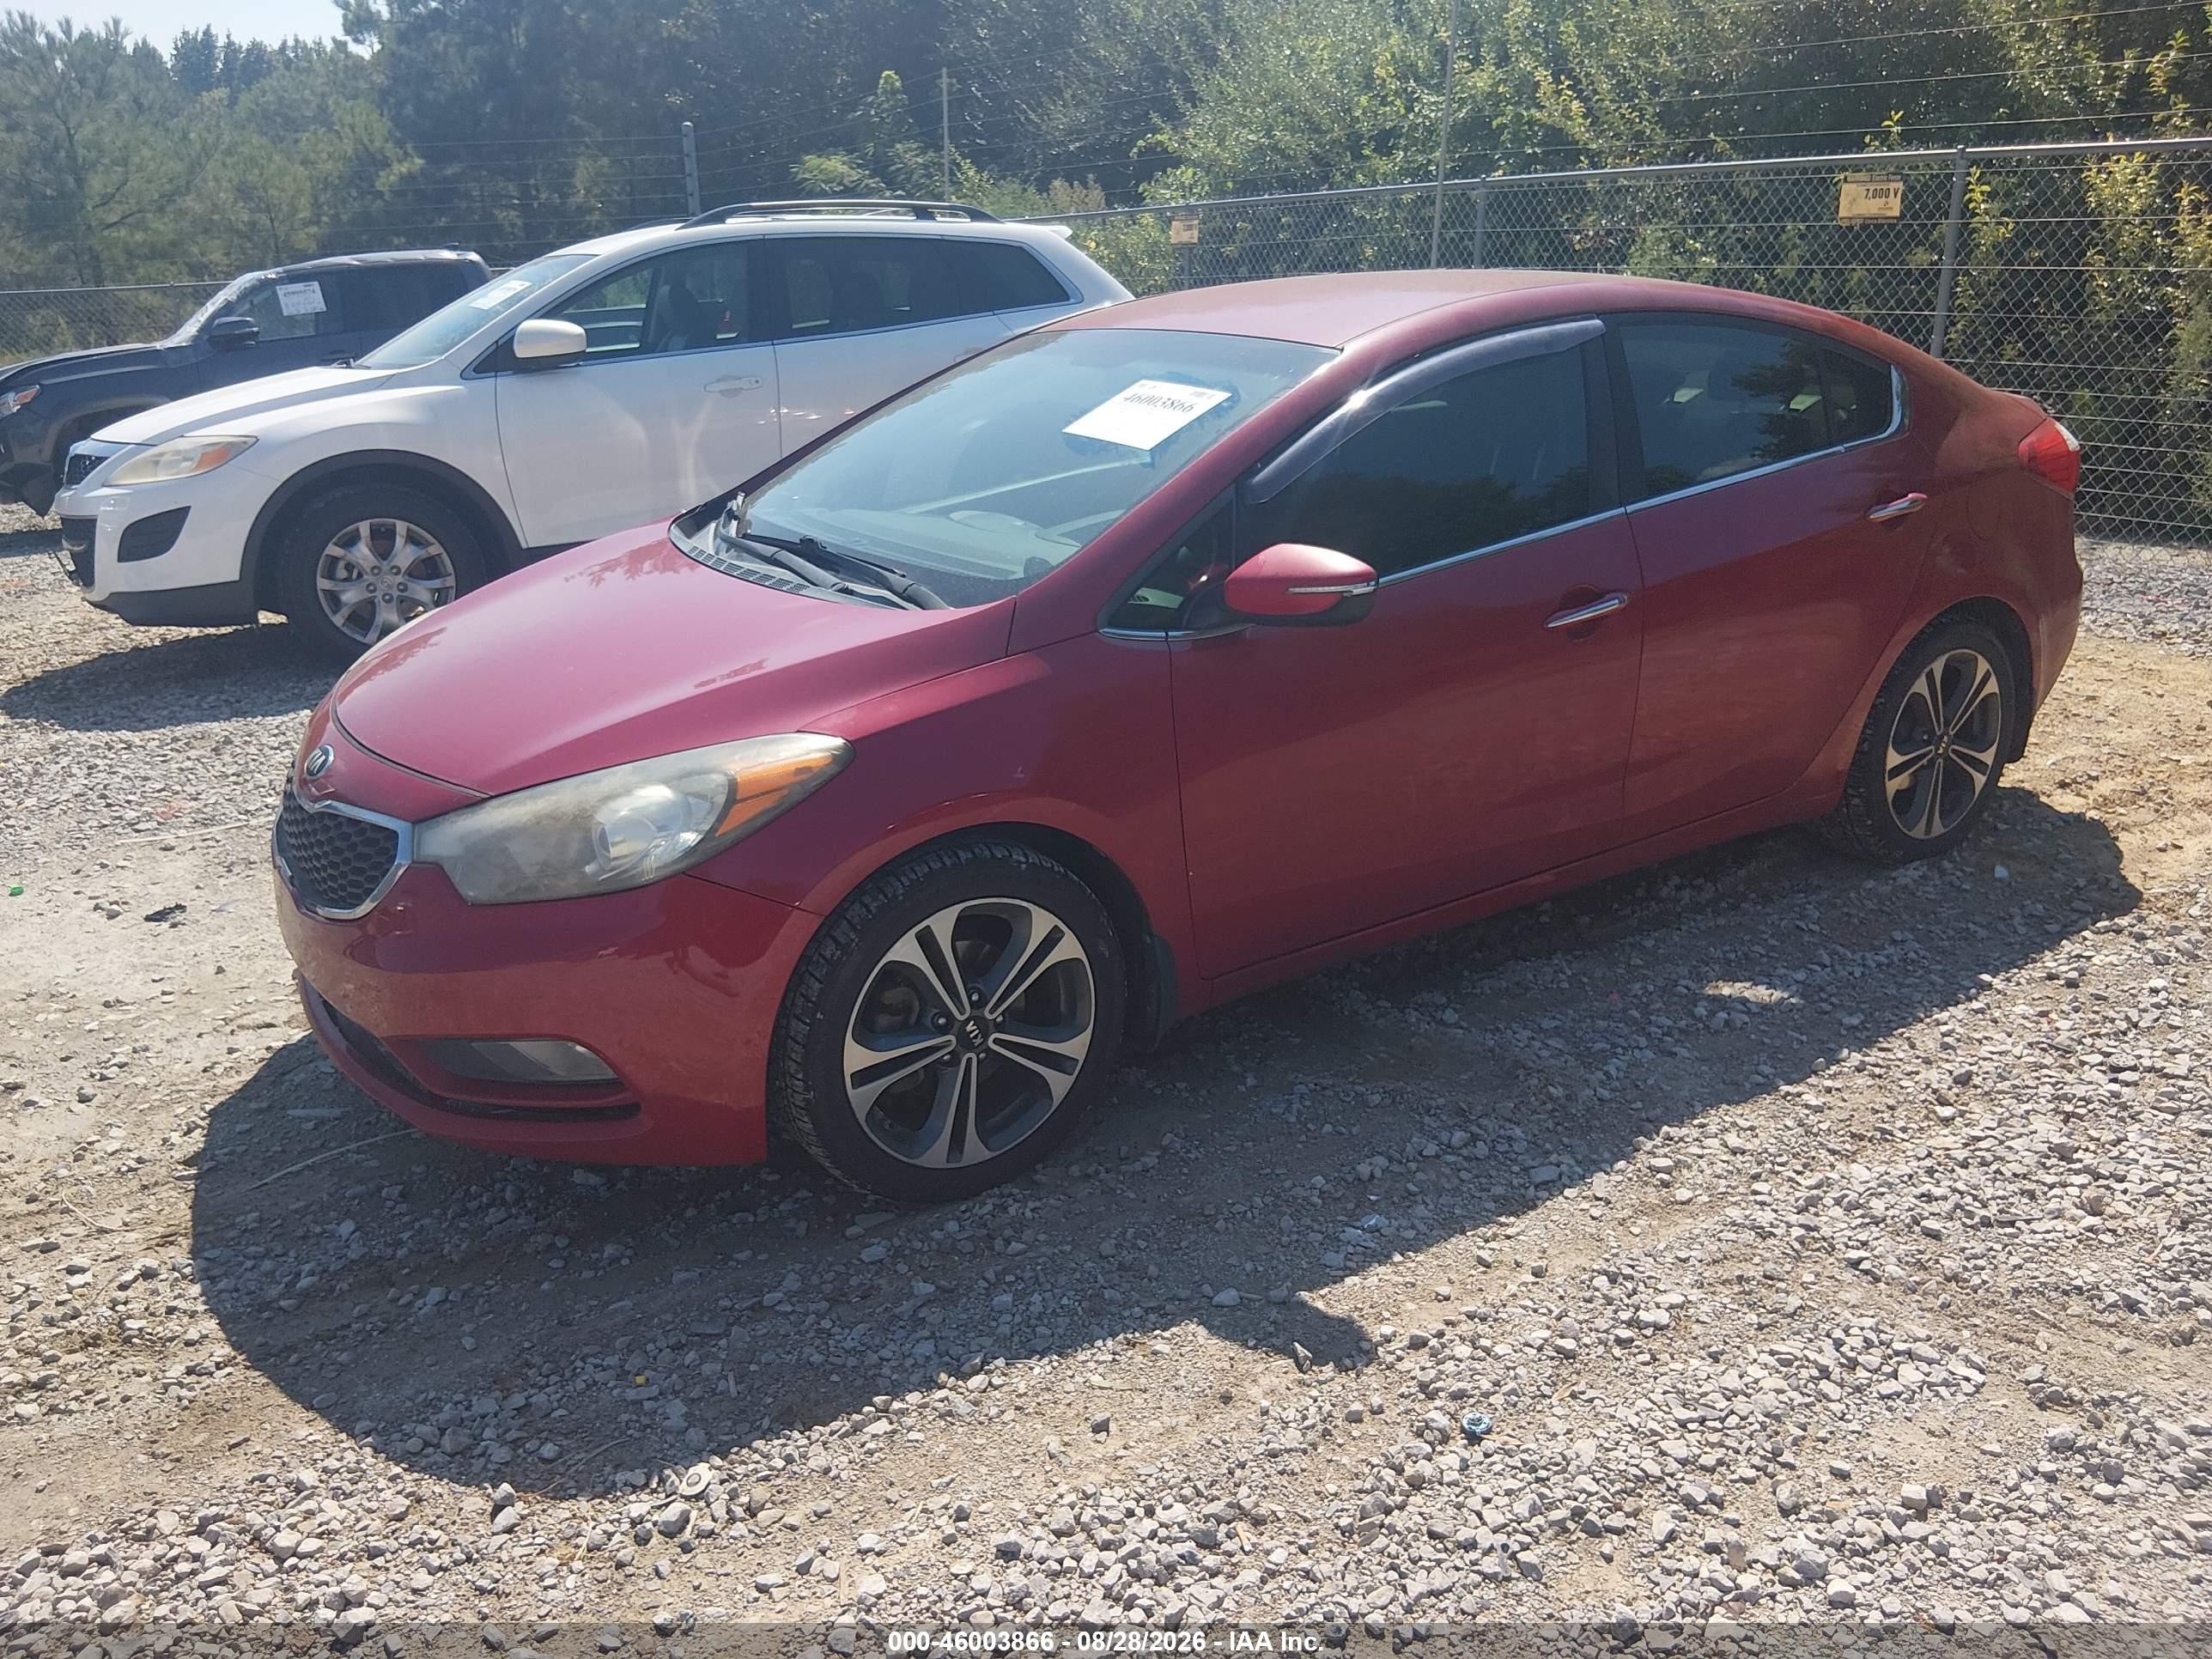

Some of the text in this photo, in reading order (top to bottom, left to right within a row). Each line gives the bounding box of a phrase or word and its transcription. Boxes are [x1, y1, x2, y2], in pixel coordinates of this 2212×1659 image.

[1863, 187, 1899, 201] 7,000 V
[1123, 392, 1196, 413] 46003866
